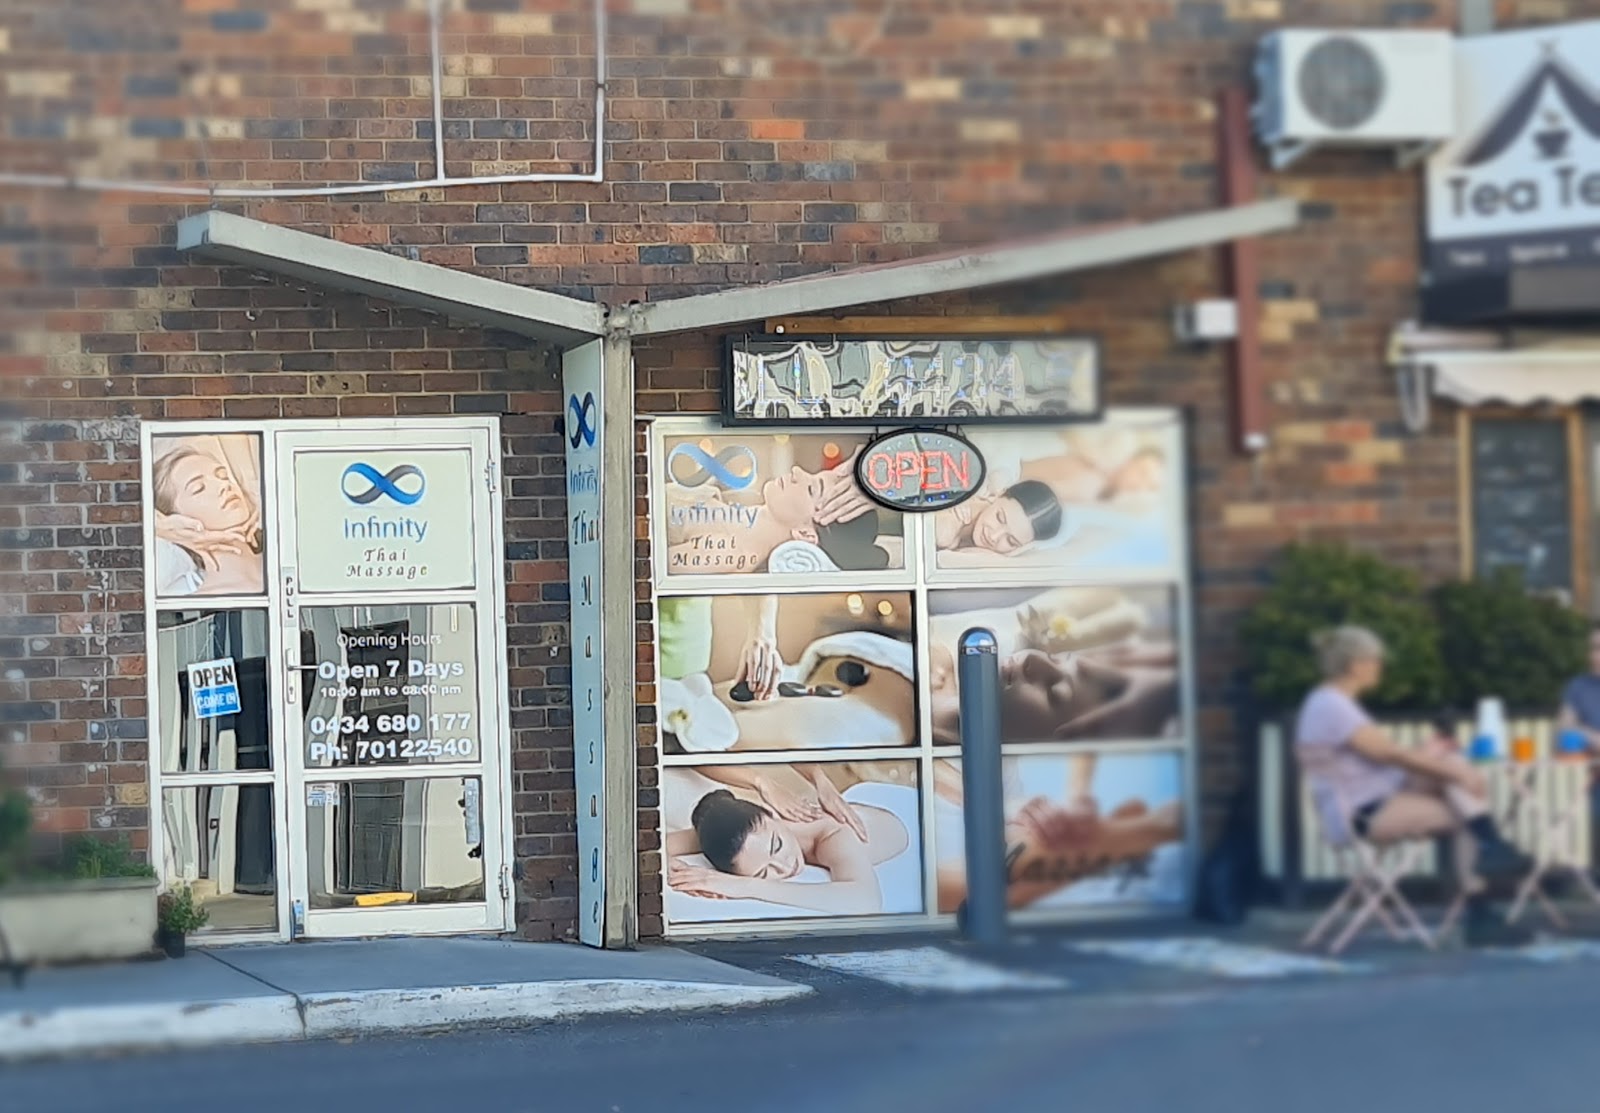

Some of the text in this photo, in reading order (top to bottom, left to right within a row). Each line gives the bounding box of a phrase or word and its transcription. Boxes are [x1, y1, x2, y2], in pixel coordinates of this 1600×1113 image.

[1445, 175, 1541, 217] Tea
[867, 450, 969, 490] OPEN
[344, 515, 428, 543] Infinity
[571, 510, 600, 546] Thai
[690, 534, 737, 550] Thai
[364, 547, 407, 562] Thai
[671, 552, 758, 570] Massage
[345, 564, 428, 580] Massage
[285, 576, 295, 619] PULL
[336, 632, 442, 650] Opening Hours
[192, 664, 234, 688] OPEN
[318, 659, 464, 683] Open 7 Days
[320, 685, 358, 698] 10:00
[360, 687, 381, 697] am
[383, 685, 399, 697] to
[440, 685, 462, 697] pm
[310, 712, 472, 735] 0434 680 177
[310, 738, 473, 761] Ph: 70122540
